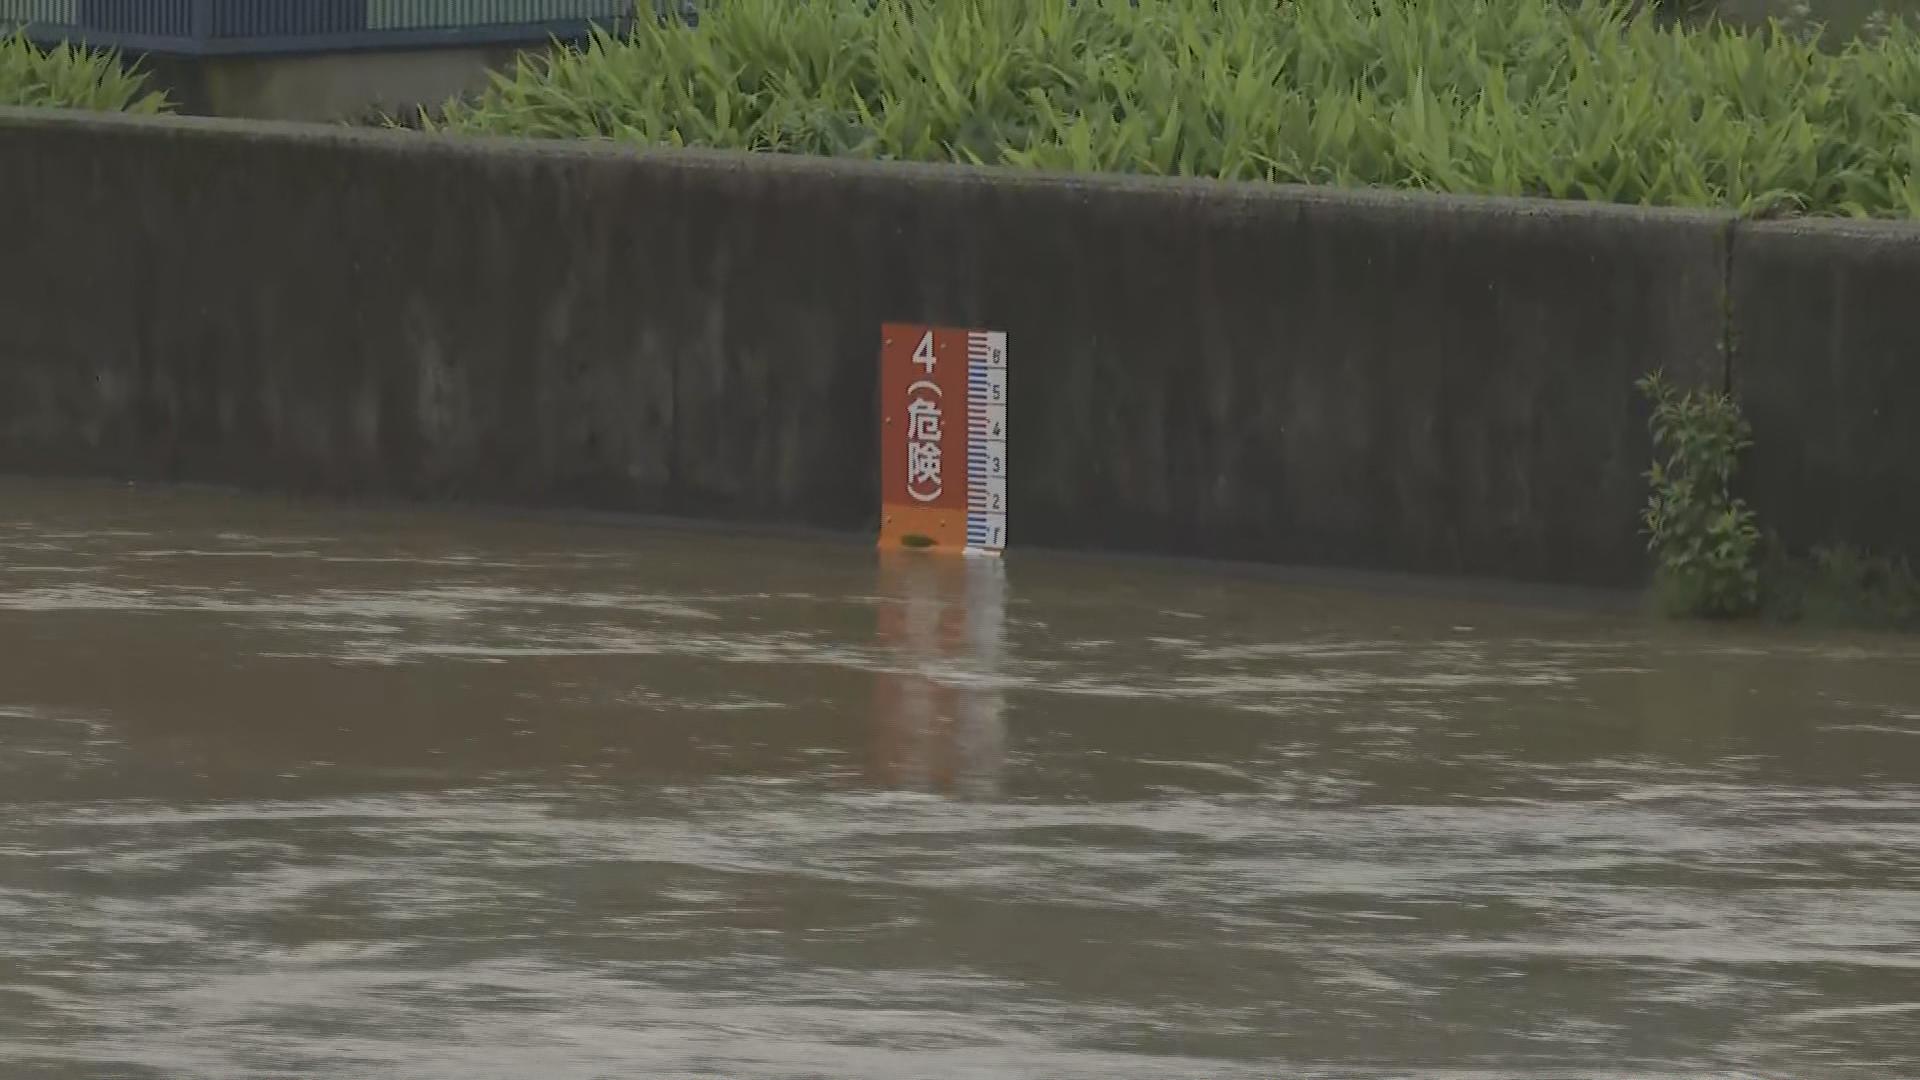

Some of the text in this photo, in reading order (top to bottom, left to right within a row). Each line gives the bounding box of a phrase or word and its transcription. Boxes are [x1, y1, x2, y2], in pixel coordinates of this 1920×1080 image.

[992, 383, 1001, 401] 5
[991, 420, 1001, 437] 4
[992, 456, 1001, 473] 3
[992, 493, 1001, 510] 2
